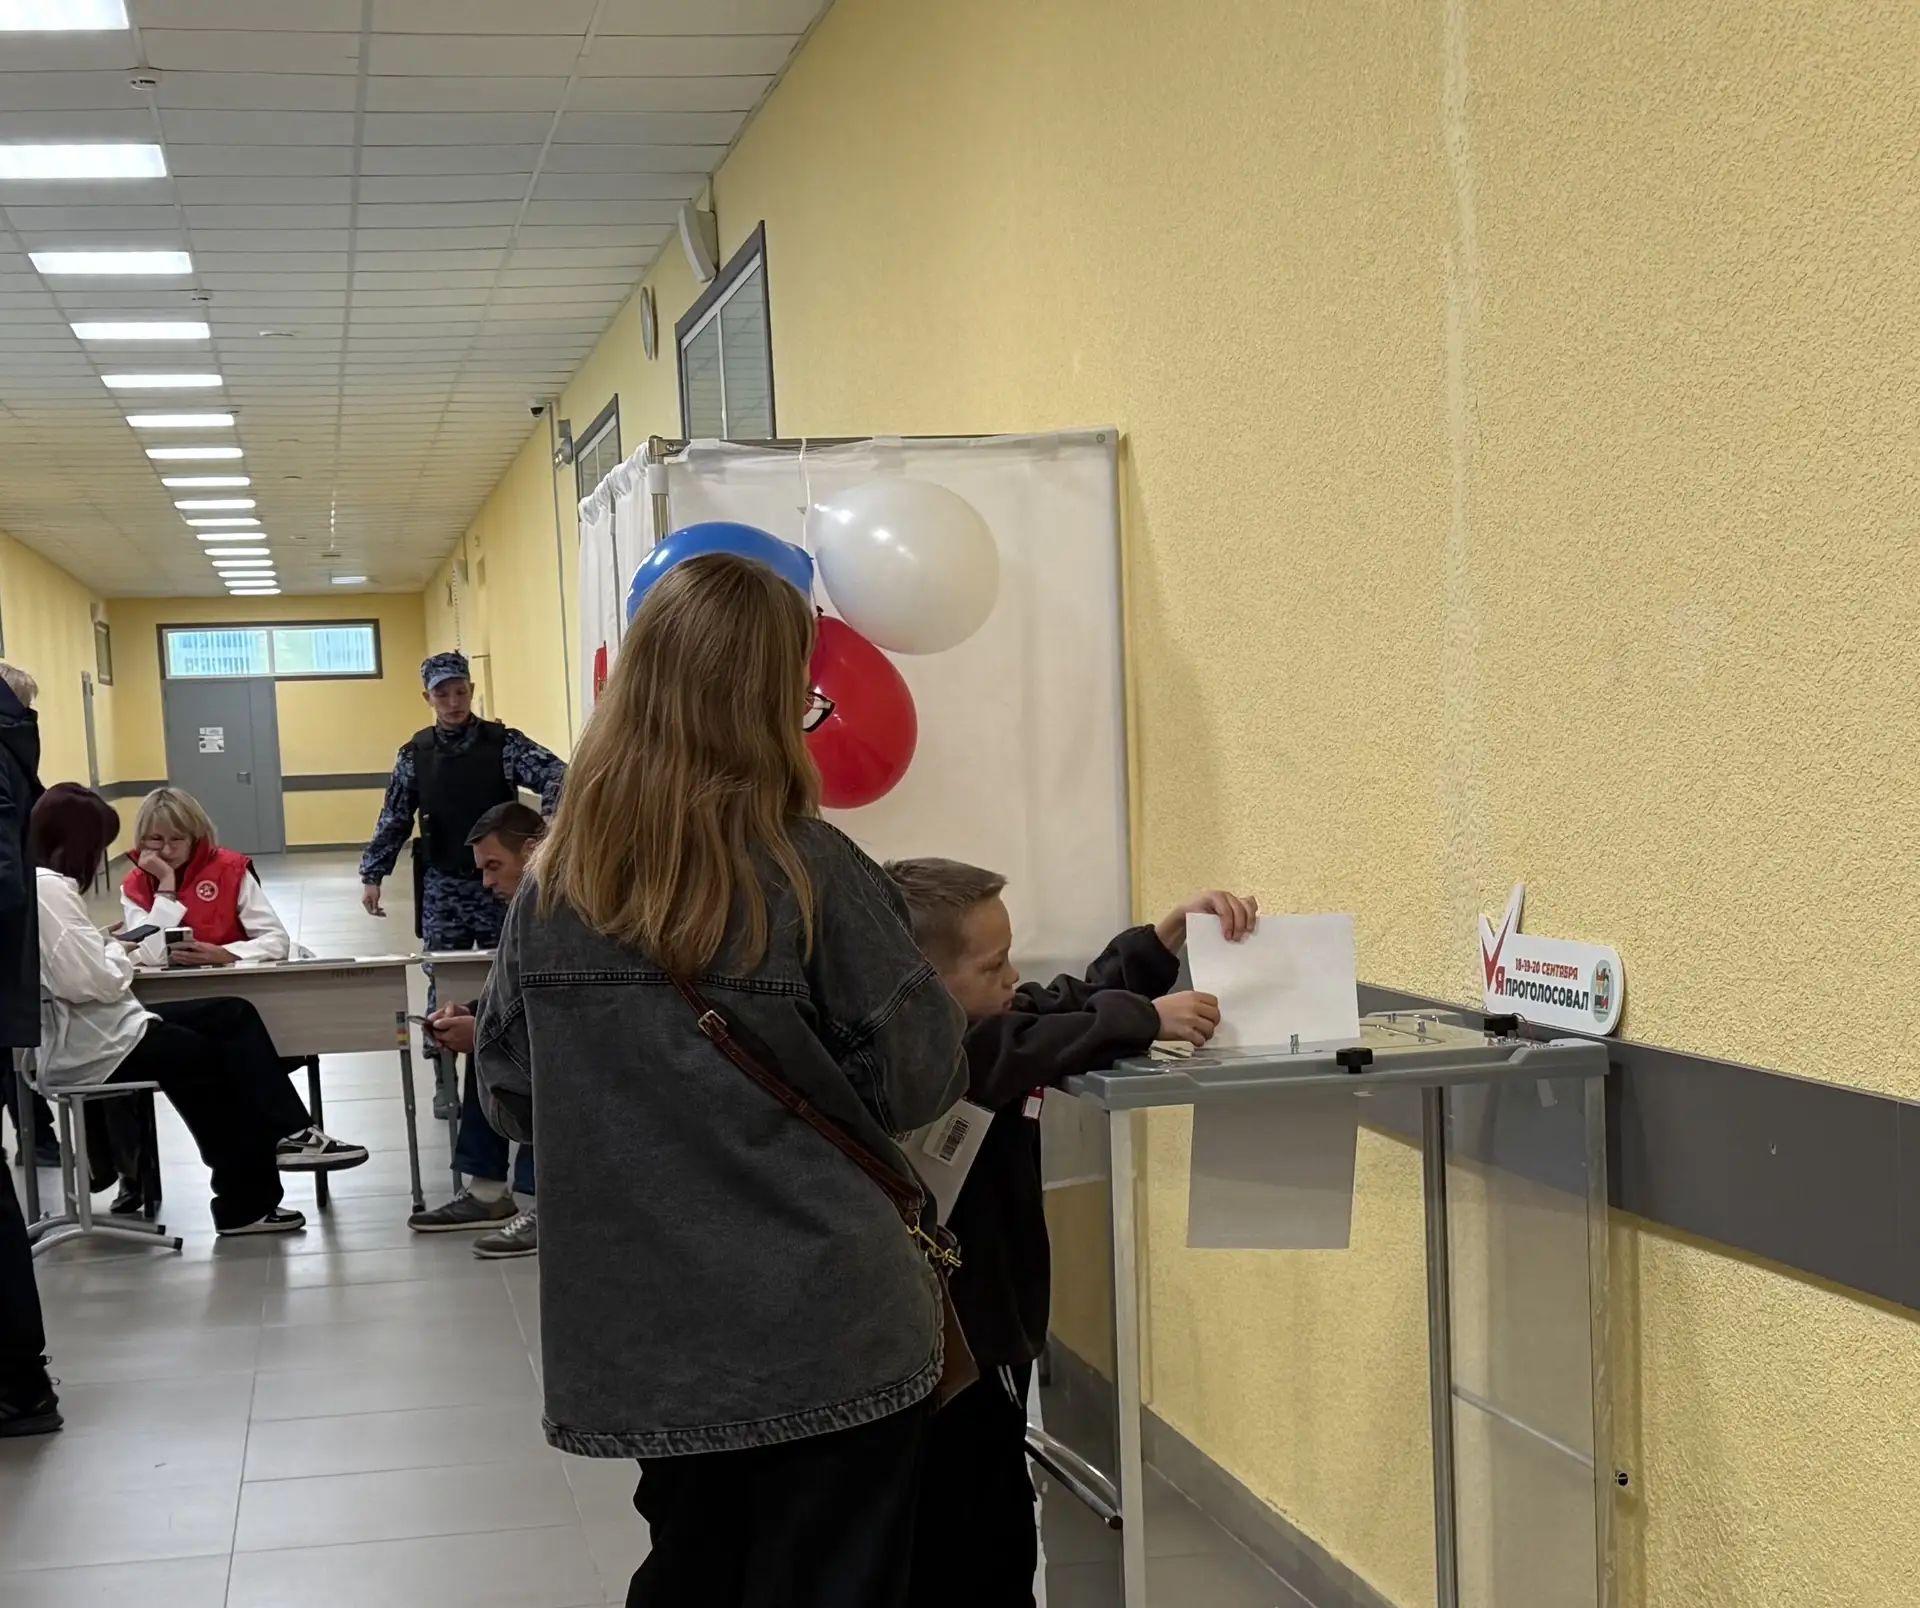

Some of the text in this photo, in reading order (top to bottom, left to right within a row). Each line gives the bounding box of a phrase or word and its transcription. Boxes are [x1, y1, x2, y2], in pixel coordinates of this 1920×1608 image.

[1541, 962, 1578, 981] СЕНТЯБРЯ
[1494, 966, 1505, 996] Я
[1505, 977, 1589, 1011] ПРОГОЛОСОВАЛ
